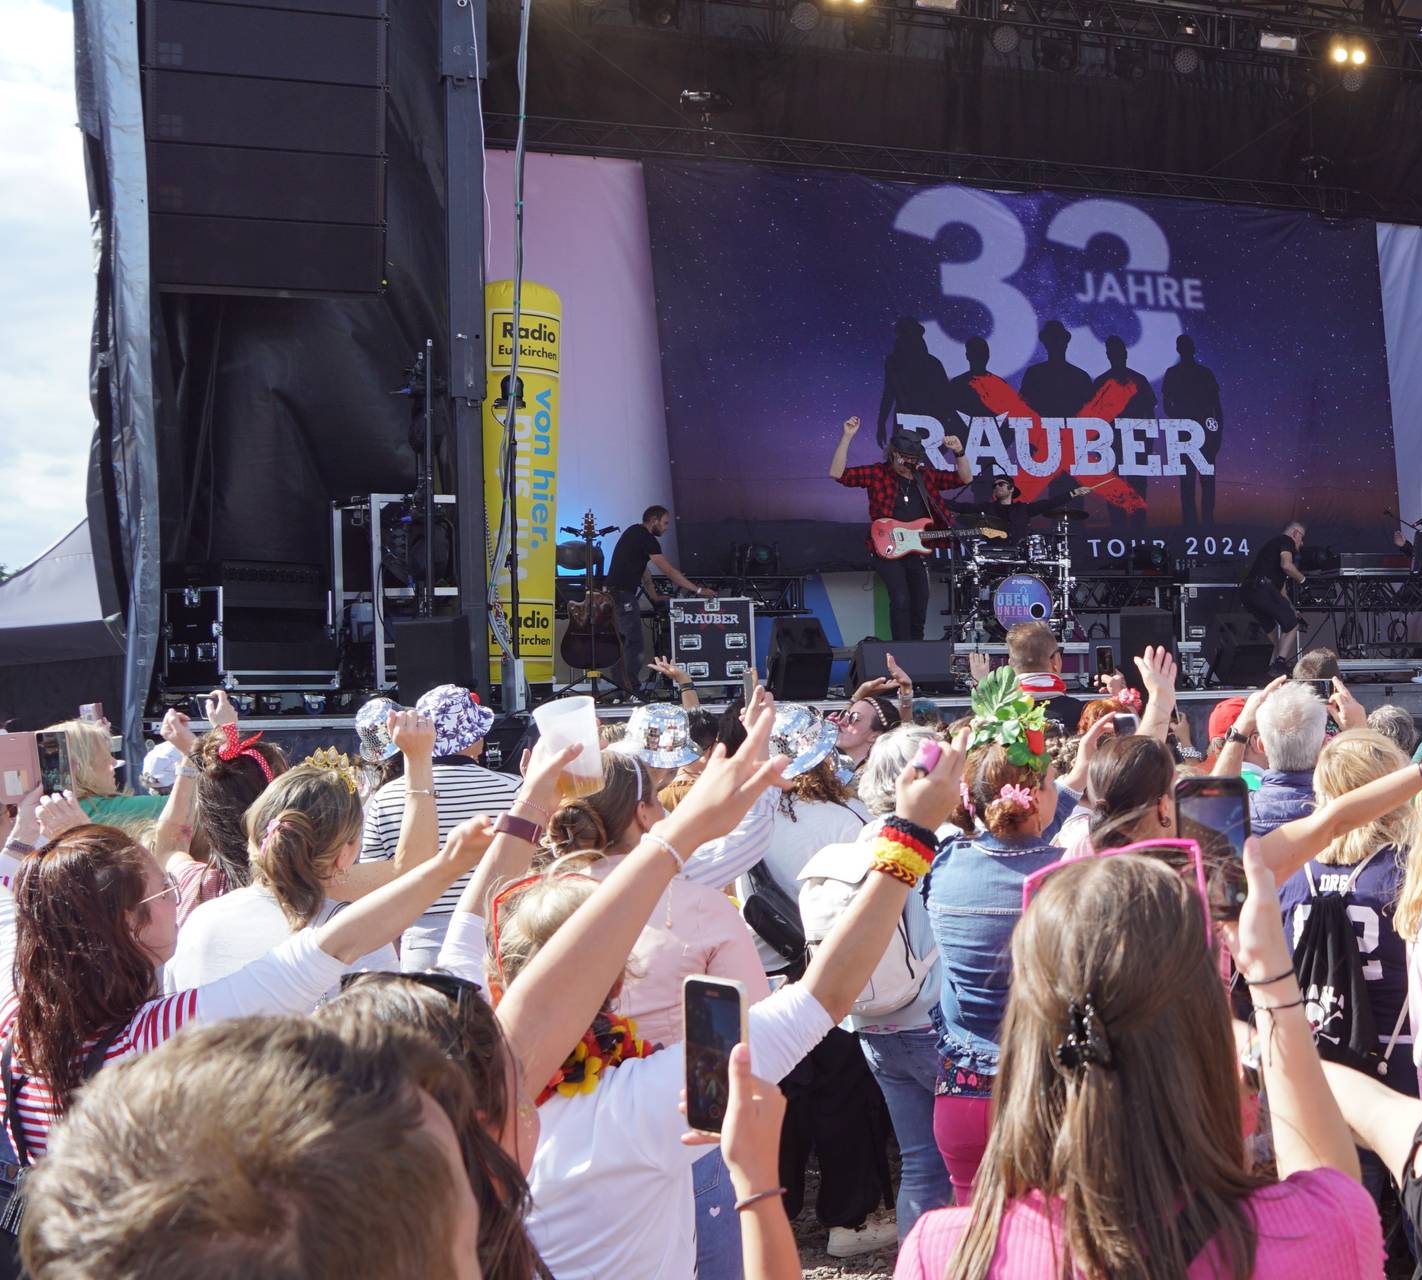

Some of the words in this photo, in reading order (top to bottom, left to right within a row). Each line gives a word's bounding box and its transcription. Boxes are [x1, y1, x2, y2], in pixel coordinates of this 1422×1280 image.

[1076, 271, 1204, 310] JAHRE
[502, 321, 556, 343] Radio
[498, 344, 557, 360] Eukirchen
[534, 388, 552, 456] von
[530, 468, 556, 550] hier.
[1185, 536, 1250, 556] 2024
[997, 594, 1029, 606] OBEN
[997, 606, 1029, 616] UNTEN
